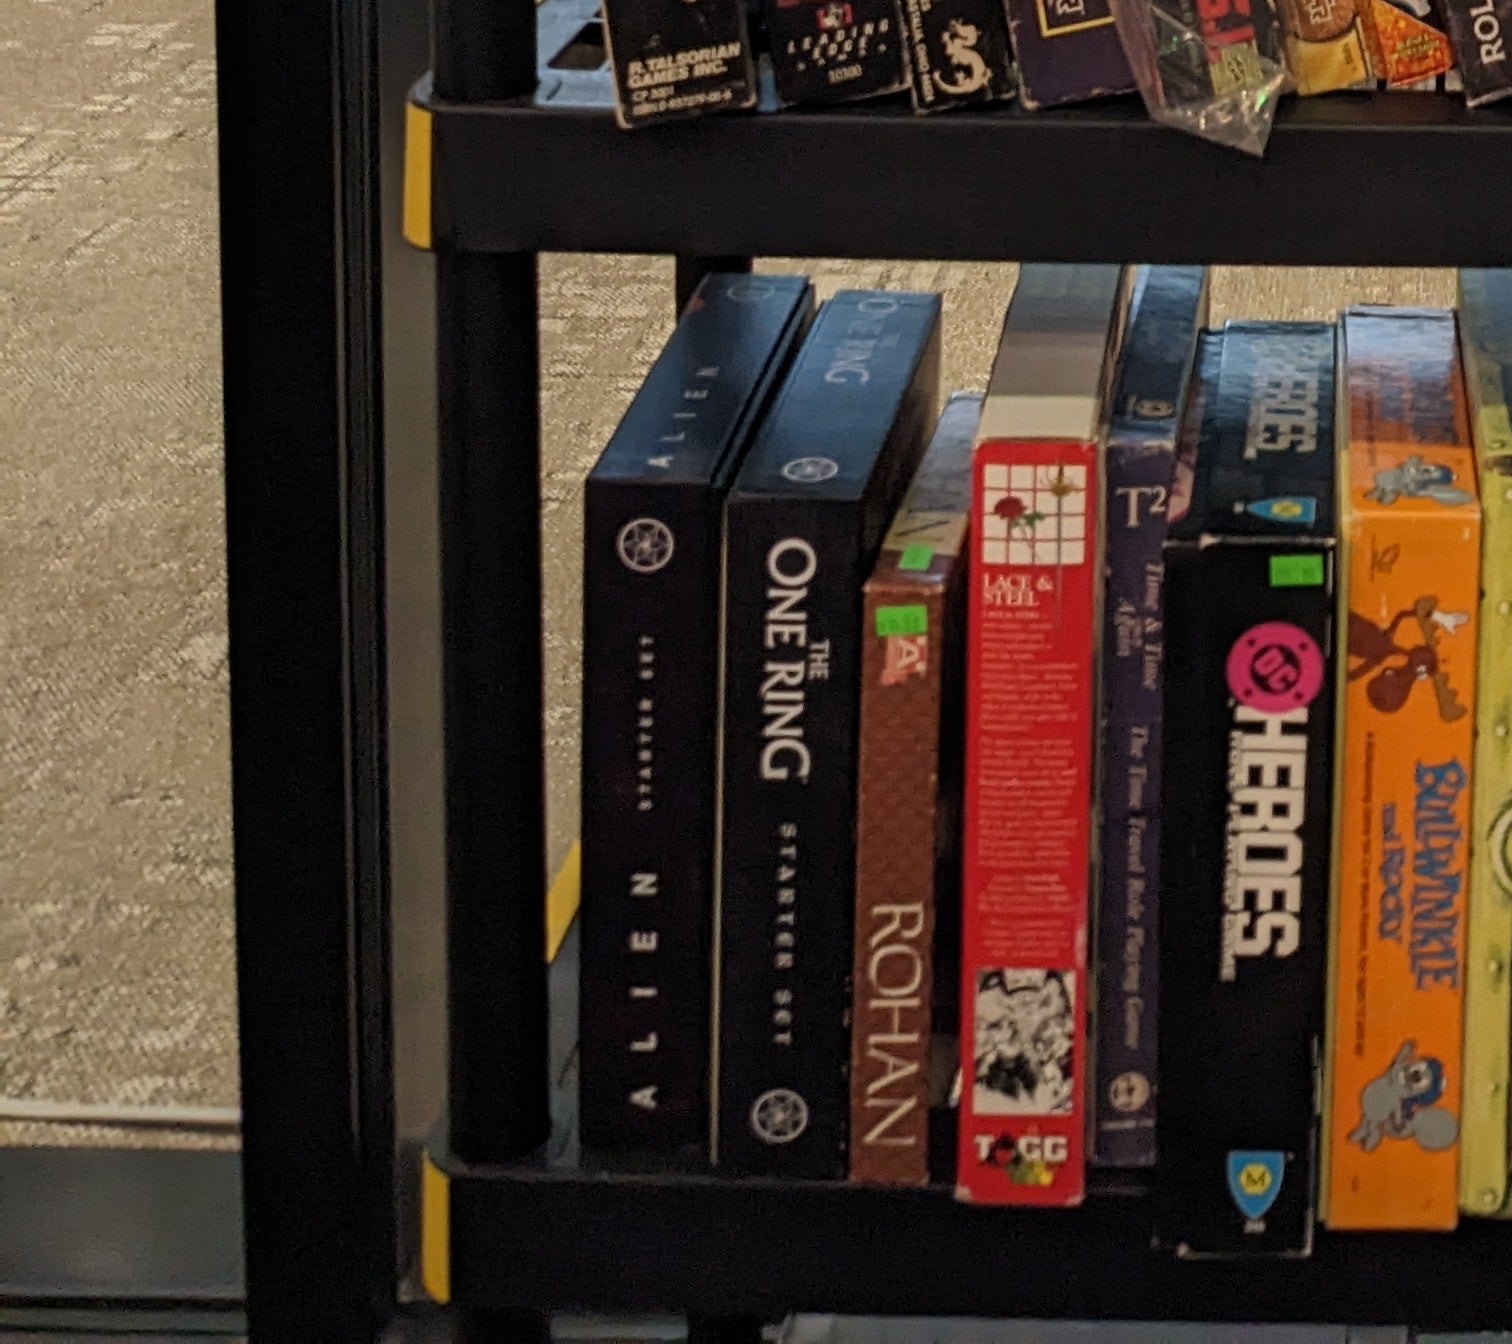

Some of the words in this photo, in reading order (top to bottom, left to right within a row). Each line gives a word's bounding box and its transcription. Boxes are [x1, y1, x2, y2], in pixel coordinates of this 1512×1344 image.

[646, 42, 741, 71] TALSORIAN
[787, 18, 889, 54] LEADING
[812, 36, 868, 60] EDGE
[628, 64, 689, 90] GAMES
[761, 536, 818, 650] ONE
[983, 573, 1031, 592] LACE
[1036, 575, 1054, 592] &
[983, 590, 1040, 606] STEEL
[1143, 561, 1164, 610] Time
[1143, 614, 1162, 634] &
[805, 636, 830, 681] THE
[1140, 642, 1163, 692] Time
[754, 658, 815, 784] RING
[636, 696, 655, 811] STARTER
[1227, 704, 1308, 959] HEROES
[771, 822, 799, 971] STARTER
[628, 869, 660, 1110] ALIEN
[770, 988, 794, 1046] SET
[860, 899, 925, 1148] ROHAN
